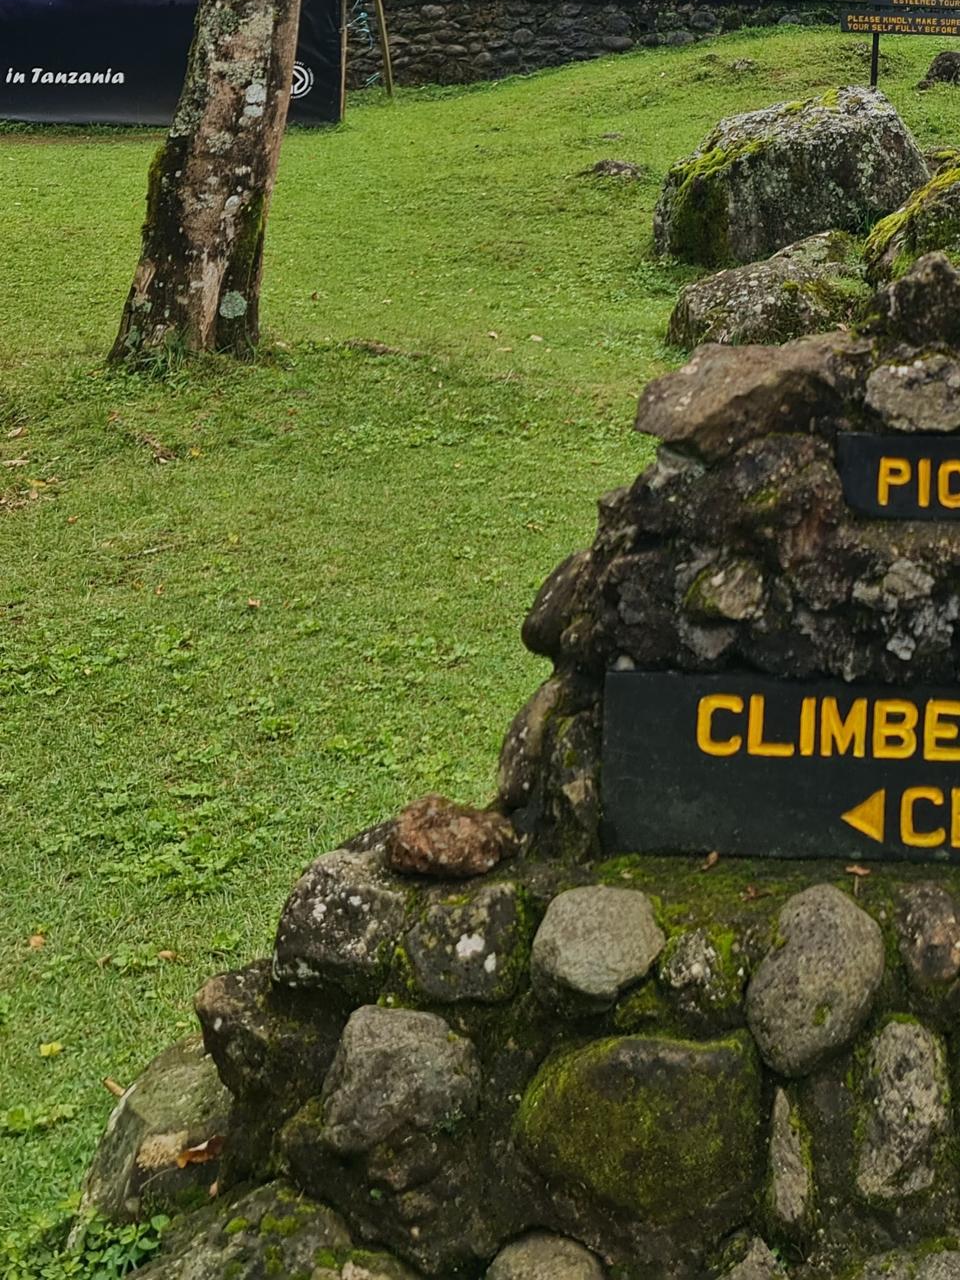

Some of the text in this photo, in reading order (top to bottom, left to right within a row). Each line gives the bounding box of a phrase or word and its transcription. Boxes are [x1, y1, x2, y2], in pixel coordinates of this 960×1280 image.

[847, 15, 880, 23] PLEASE
[883, 16, 913, 24] KINDLY
[916, 17, 937, 25] MAKE
[941, 18, 960, 26] SURE
[847, 23, 869, 31] YOUR
[872, 24, 893, 32] SELF
[895, 25, 923, 33] FULLY
[925, 26, 957, 34] BEFORE
[5, 67, 125, 84] in Tanzania
